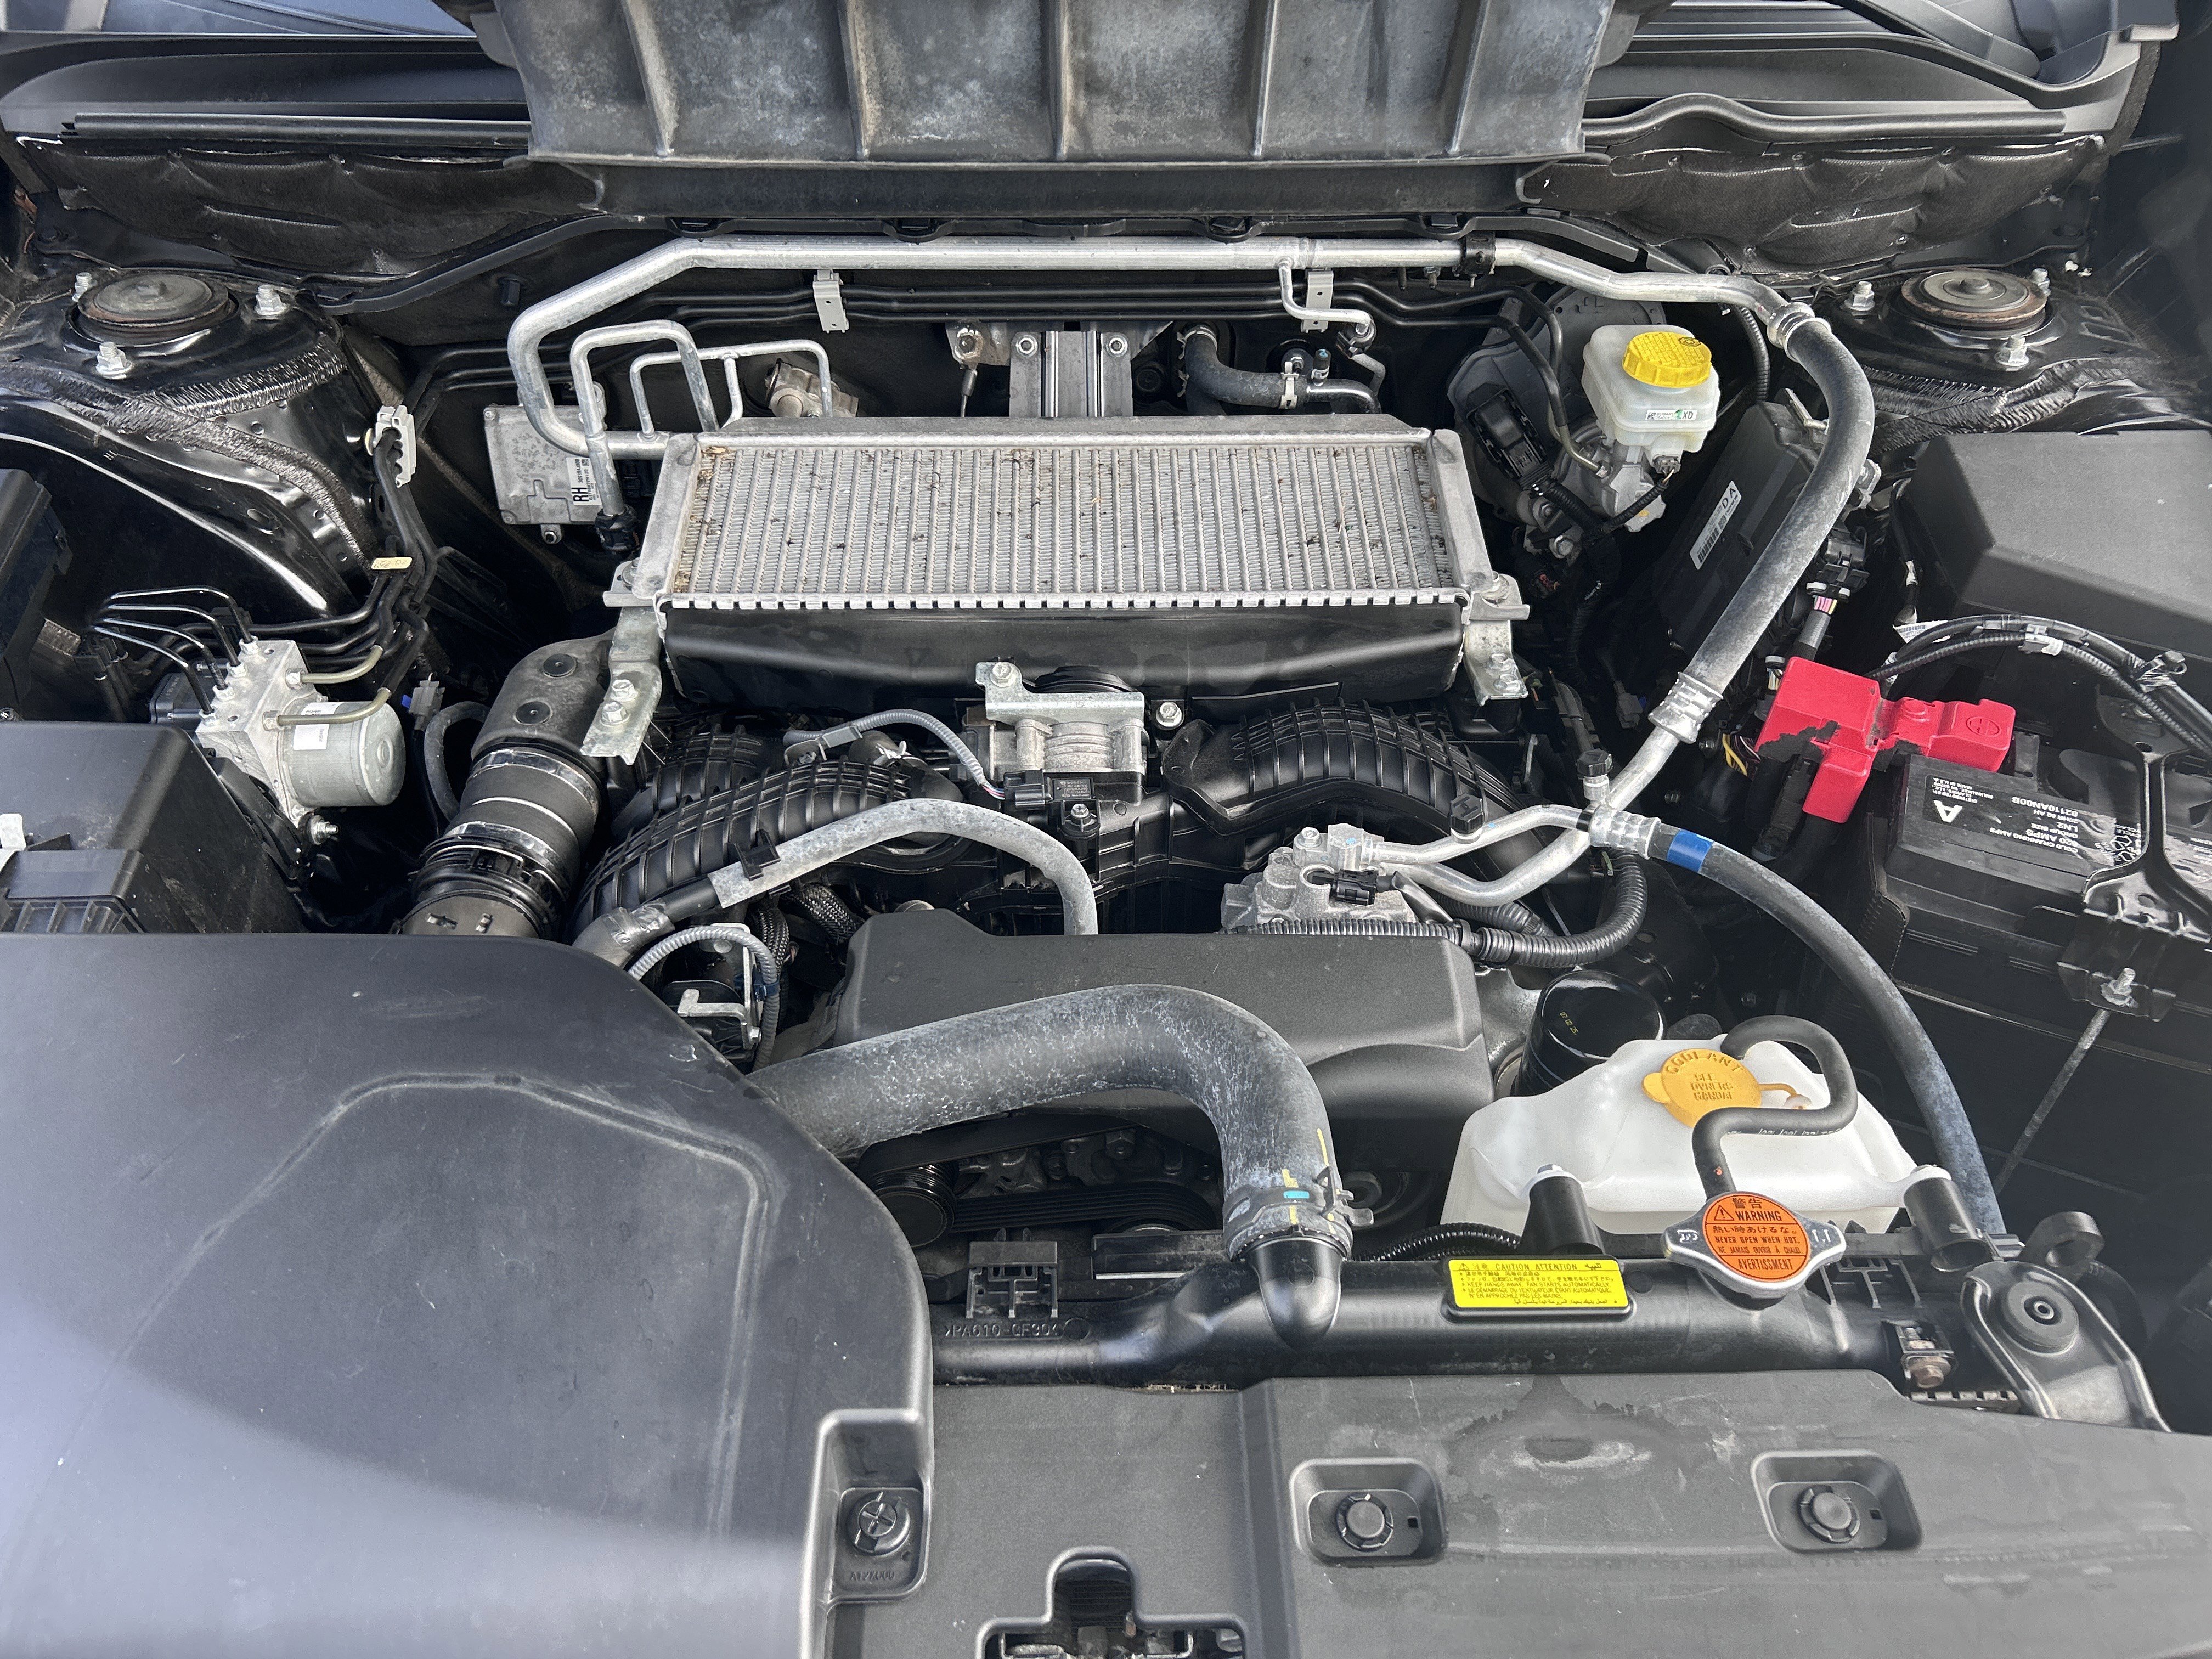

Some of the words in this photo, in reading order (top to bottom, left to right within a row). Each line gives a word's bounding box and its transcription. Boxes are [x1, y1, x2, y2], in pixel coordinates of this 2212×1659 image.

[1682, 411, 1694, 419] XD
[571, 487, 589, 501] RH
[2012, 797, 2078, 817] 82110AN00B
[1989, 827, 2012, 837] AMPS
[2057, 822, 2078, 832] LN2
[2025, 829, 2057, 842] AMPS
[2049, 828, 2078, 838] GROUP
[2013, 833, 2055, 847] CRANKING
[2056, 844, 2078, 853] COLD
[1666, 1051, 1742, 1073] COOLANT
[1694, 1073, 1716, 1081] SEE
[1694, 1092, 1734, 1101] MANUAL
[1732, 1198, 1762, 1209] 警告
[1735, 1210, 1782, 1221] WARNING
[1713, 1226, 1797, 1234] 熱い時あけるな。
[1812, 1229, 1831, 1242] 1.1
[1775, 1245, 1780, 1254] À
[1737, 1259, 1793, 1270] AVERTISSMENT
